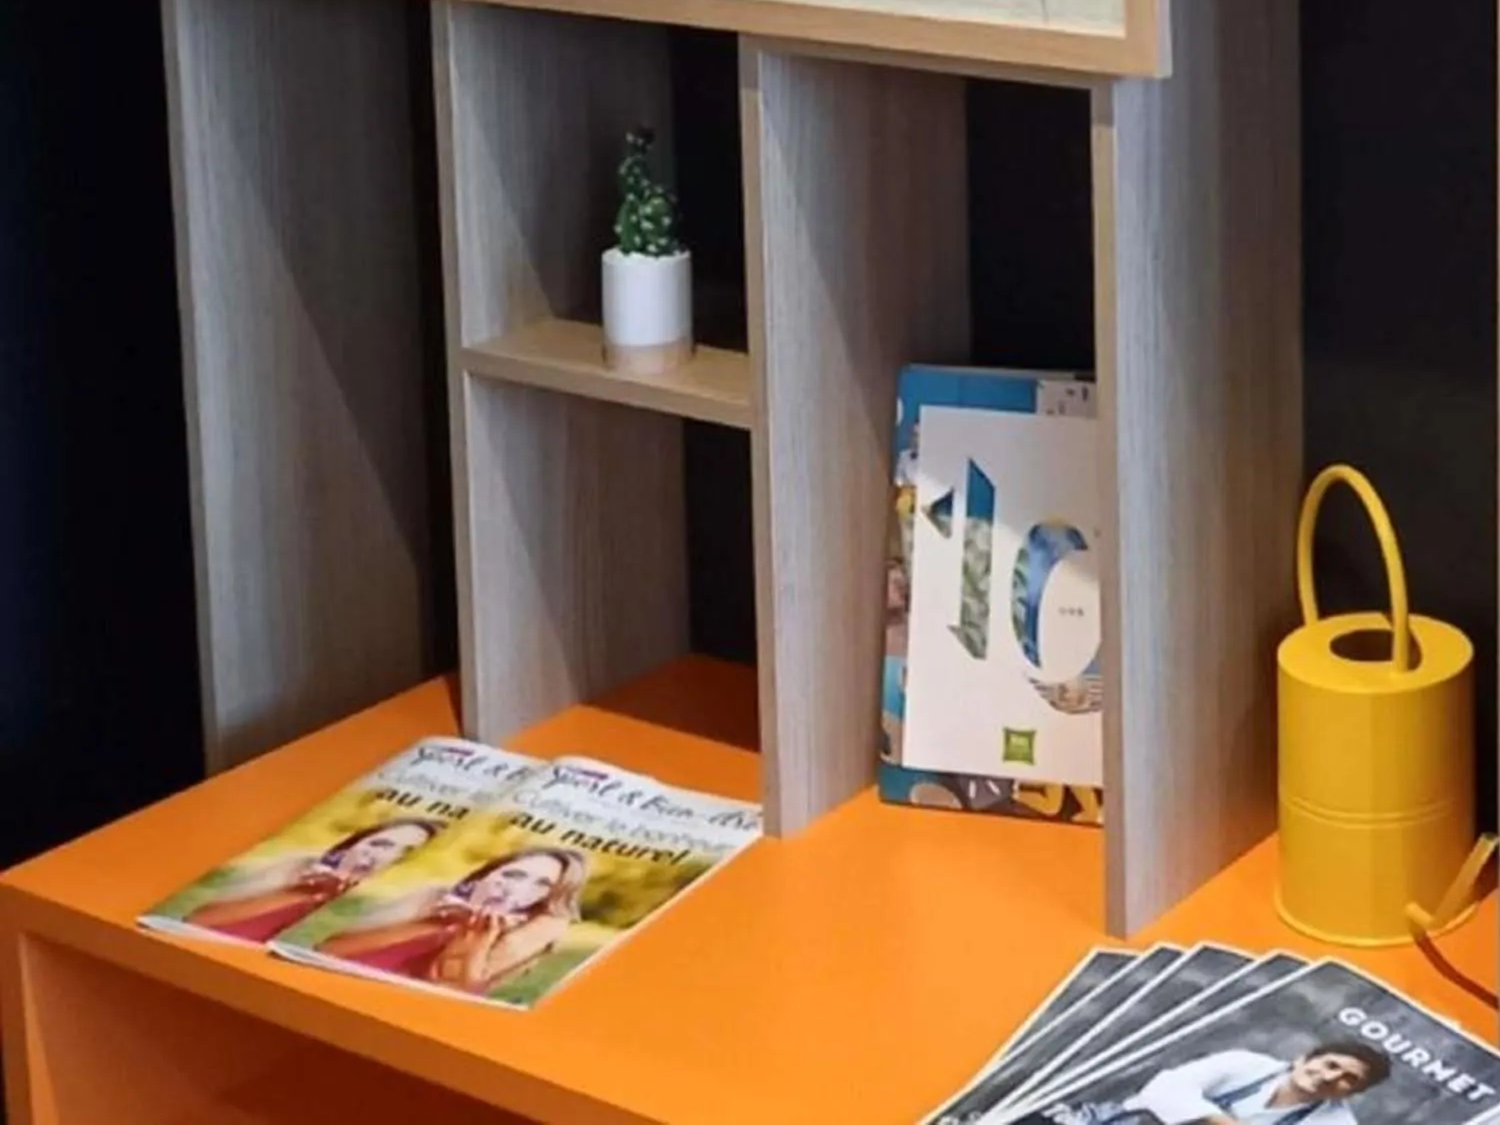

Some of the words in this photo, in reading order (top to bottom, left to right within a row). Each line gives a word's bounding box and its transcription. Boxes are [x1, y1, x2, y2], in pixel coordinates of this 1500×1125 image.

[374, 788, 423, 808] au
[509, 811, 556, 836] au
[559, 826, 691, 867] naturel
[1338, 1006, 1497, 1101] GOURMET
